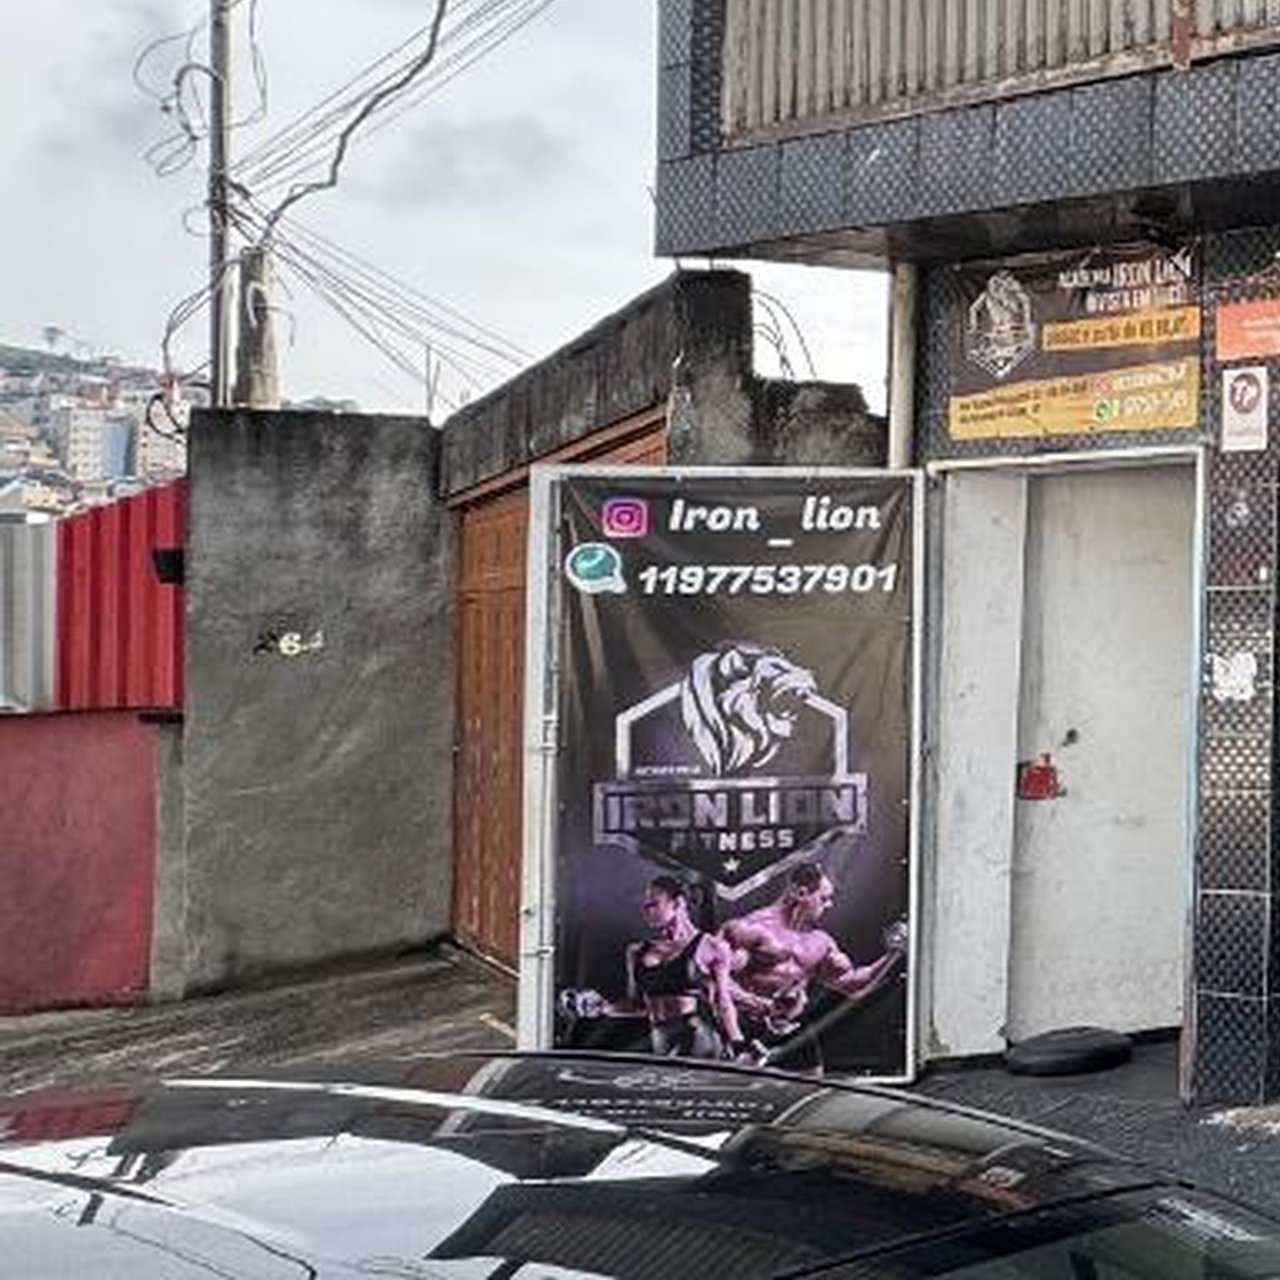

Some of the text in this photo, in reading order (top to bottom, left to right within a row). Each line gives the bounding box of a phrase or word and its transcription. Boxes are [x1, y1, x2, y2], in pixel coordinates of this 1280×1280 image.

[669, 499, 760, 531] Iron
[802, 497, 881, 530] lion
[640, 564, 897, 594] 11977537901
